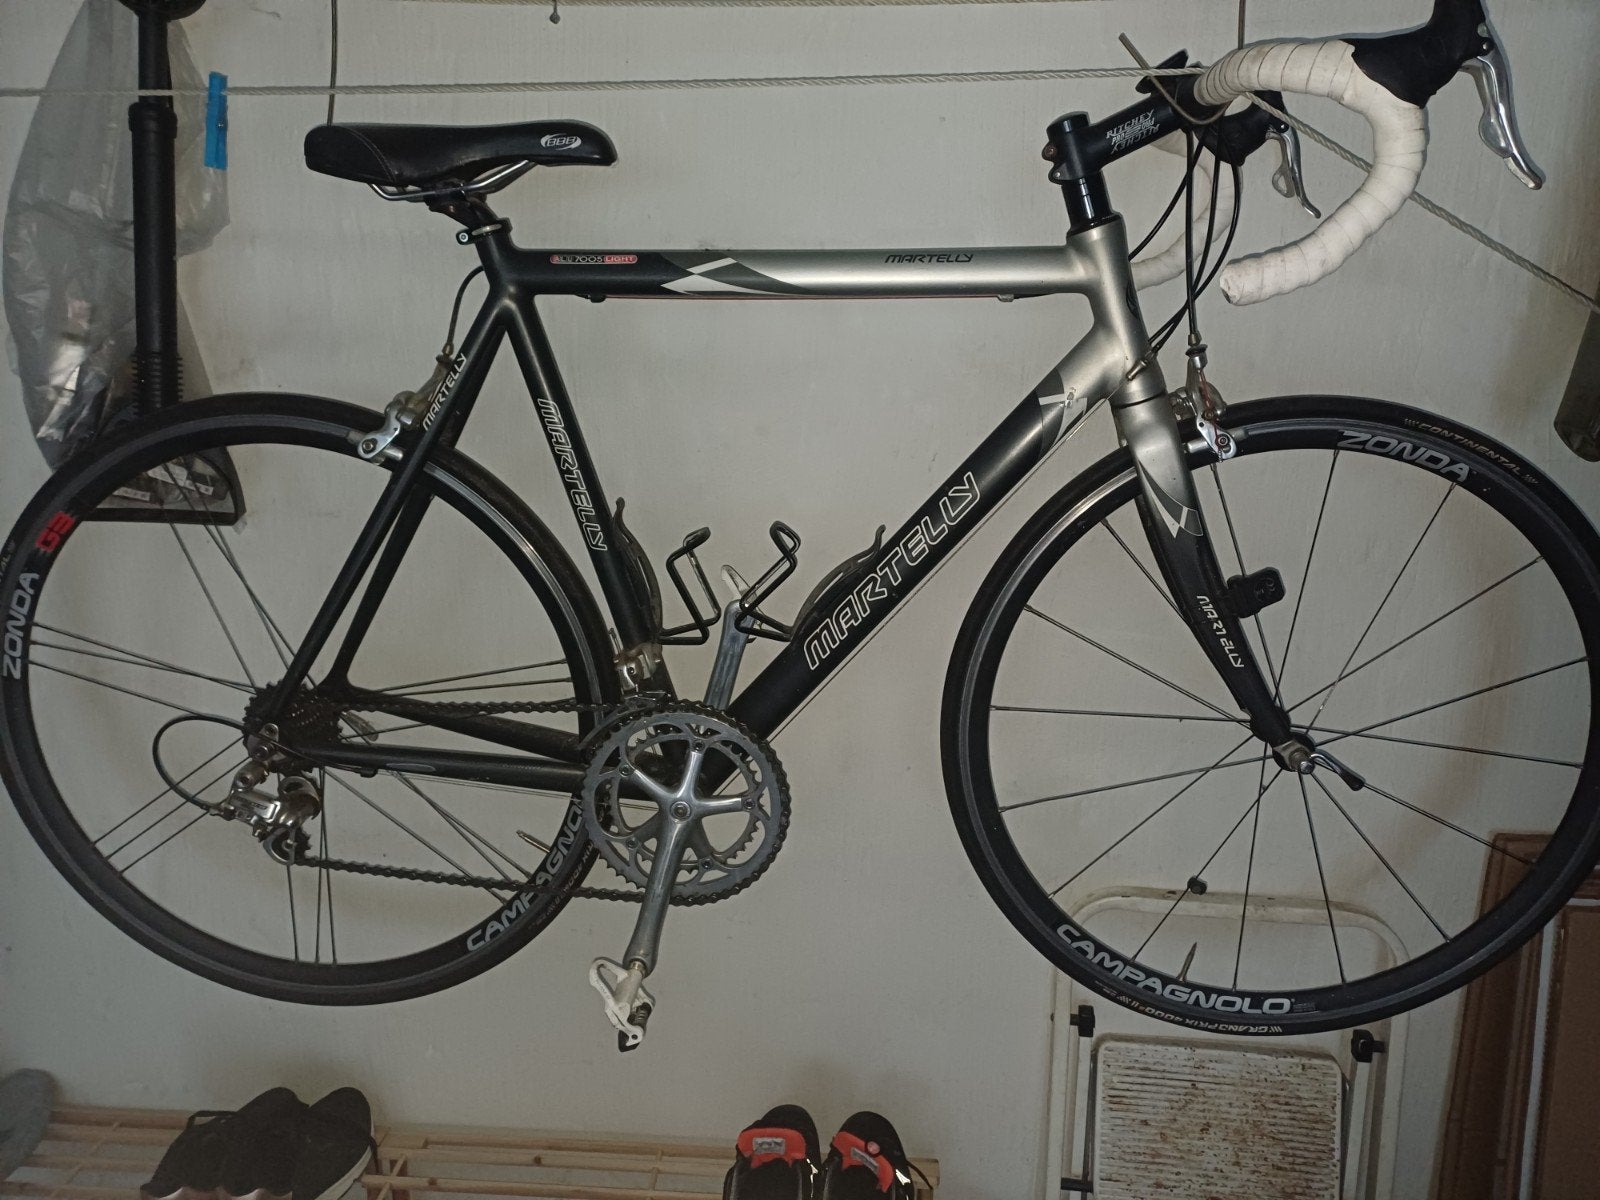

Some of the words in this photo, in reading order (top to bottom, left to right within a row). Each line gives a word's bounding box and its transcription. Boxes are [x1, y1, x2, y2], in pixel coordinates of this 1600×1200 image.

[545, 135, 578, 148] BBB
[1105, 108, 1155, 139] RITCHEY
[574, 255, 603, 263] 7005
[605, 255, 635, 263] LIGHT
[884, 253, 974, 264] MARTELLY
[422, 352, 467, 431] MARTELLY
[537, 397, 608, 551] MARTELLY
[1337, 429, 1471, 483] ZONDA
[1417, 422, 1523, 477] CONTINENTAL
[36, 511, 77, 553] G3
[803, 471, 981, 671] MARTELLY
[2, 572, 40, 680] ZONDA
[1056, 923, 1292, 1015] CAMPAGNOLO
